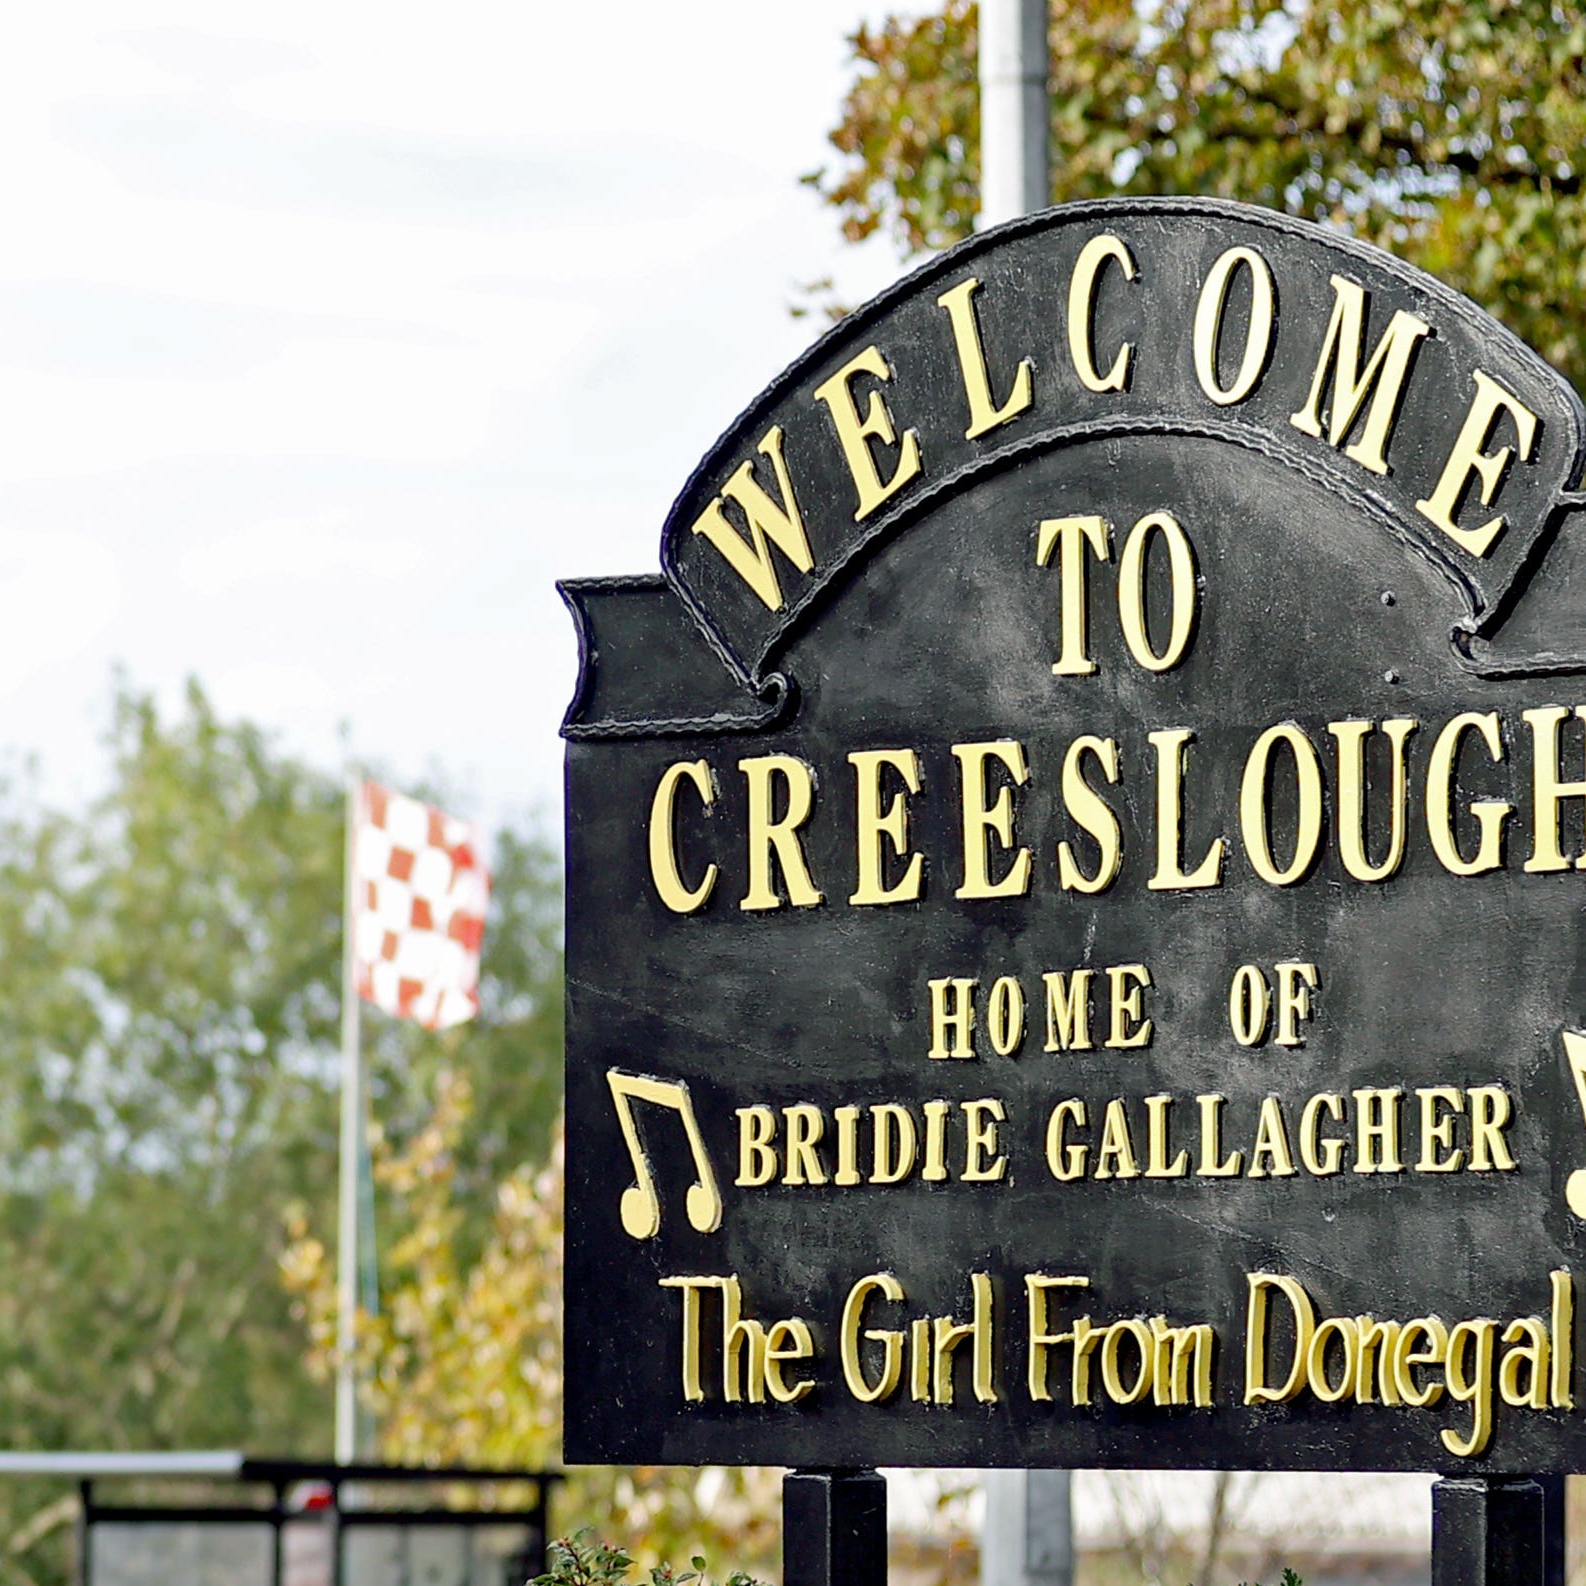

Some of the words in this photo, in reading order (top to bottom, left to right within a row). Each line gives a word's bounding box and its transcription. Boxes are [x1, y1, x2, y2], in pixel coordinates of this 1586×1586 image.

[692, 234, 1538, 612] WELCOME
[1036, 512, 1195, 674] TO
[927, 964, 1151, 1060] HOME
[1229, 963, 1319, 1047] OF
[735, 1099, 1006, 1187] BRIDIE
[1046, 1087, 1516, 1182] GALLAGHER
[659, 1274, 816, 1404] The
[1024, 1272, 1214, 1407] From
[1243, 1268, 1575, 1458] Donegal
